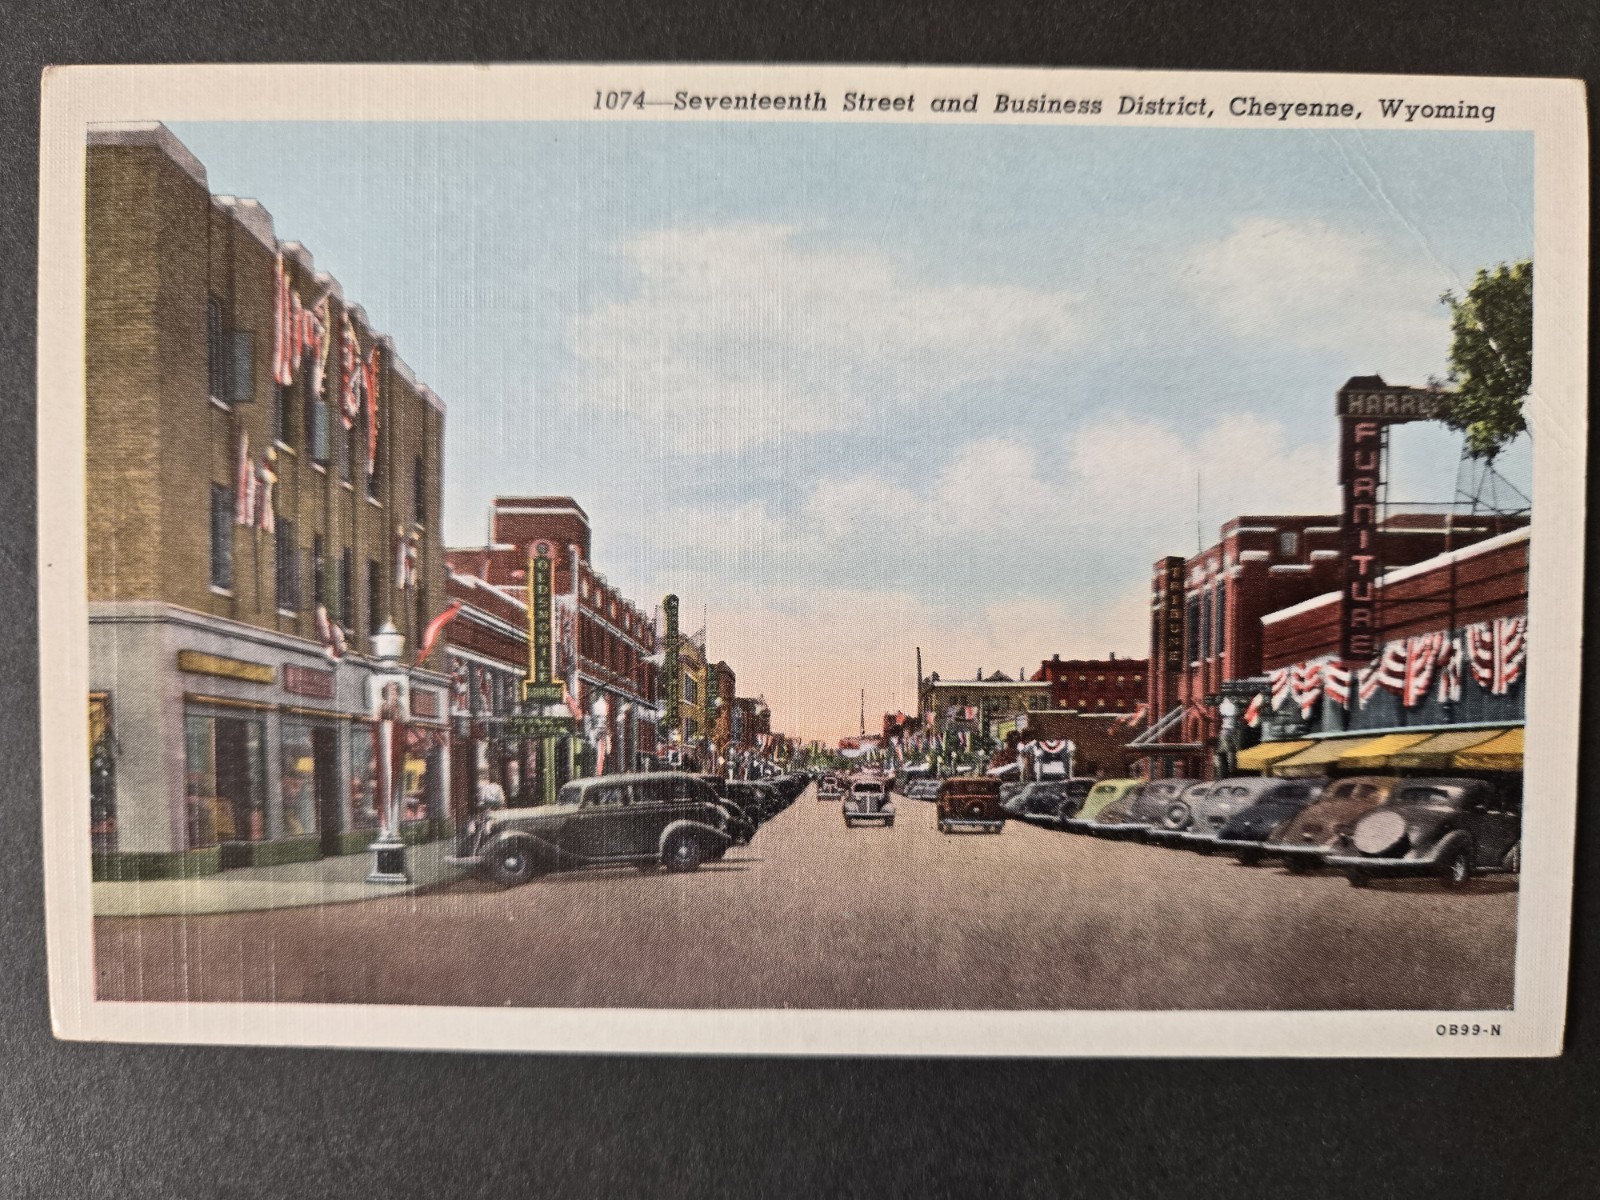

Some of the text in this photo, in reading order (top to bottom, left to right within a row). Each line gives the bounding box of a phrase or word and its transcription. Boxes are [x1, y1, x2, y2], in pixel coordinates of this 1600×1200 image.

[842, 92, 915, 112] Street
[930, 93, 979, 113] and
[993, 94, 1102, 115] Business
[1117, 95, 1216, 119] District,
[1228, 97, 1364, 121] Cheyenne,
[1378, 99, 1496, 123] Wyoming
[1351, 421, 1378, 655] FURNITURE
[536, 559, 550, 682] OLDSMOBILE
